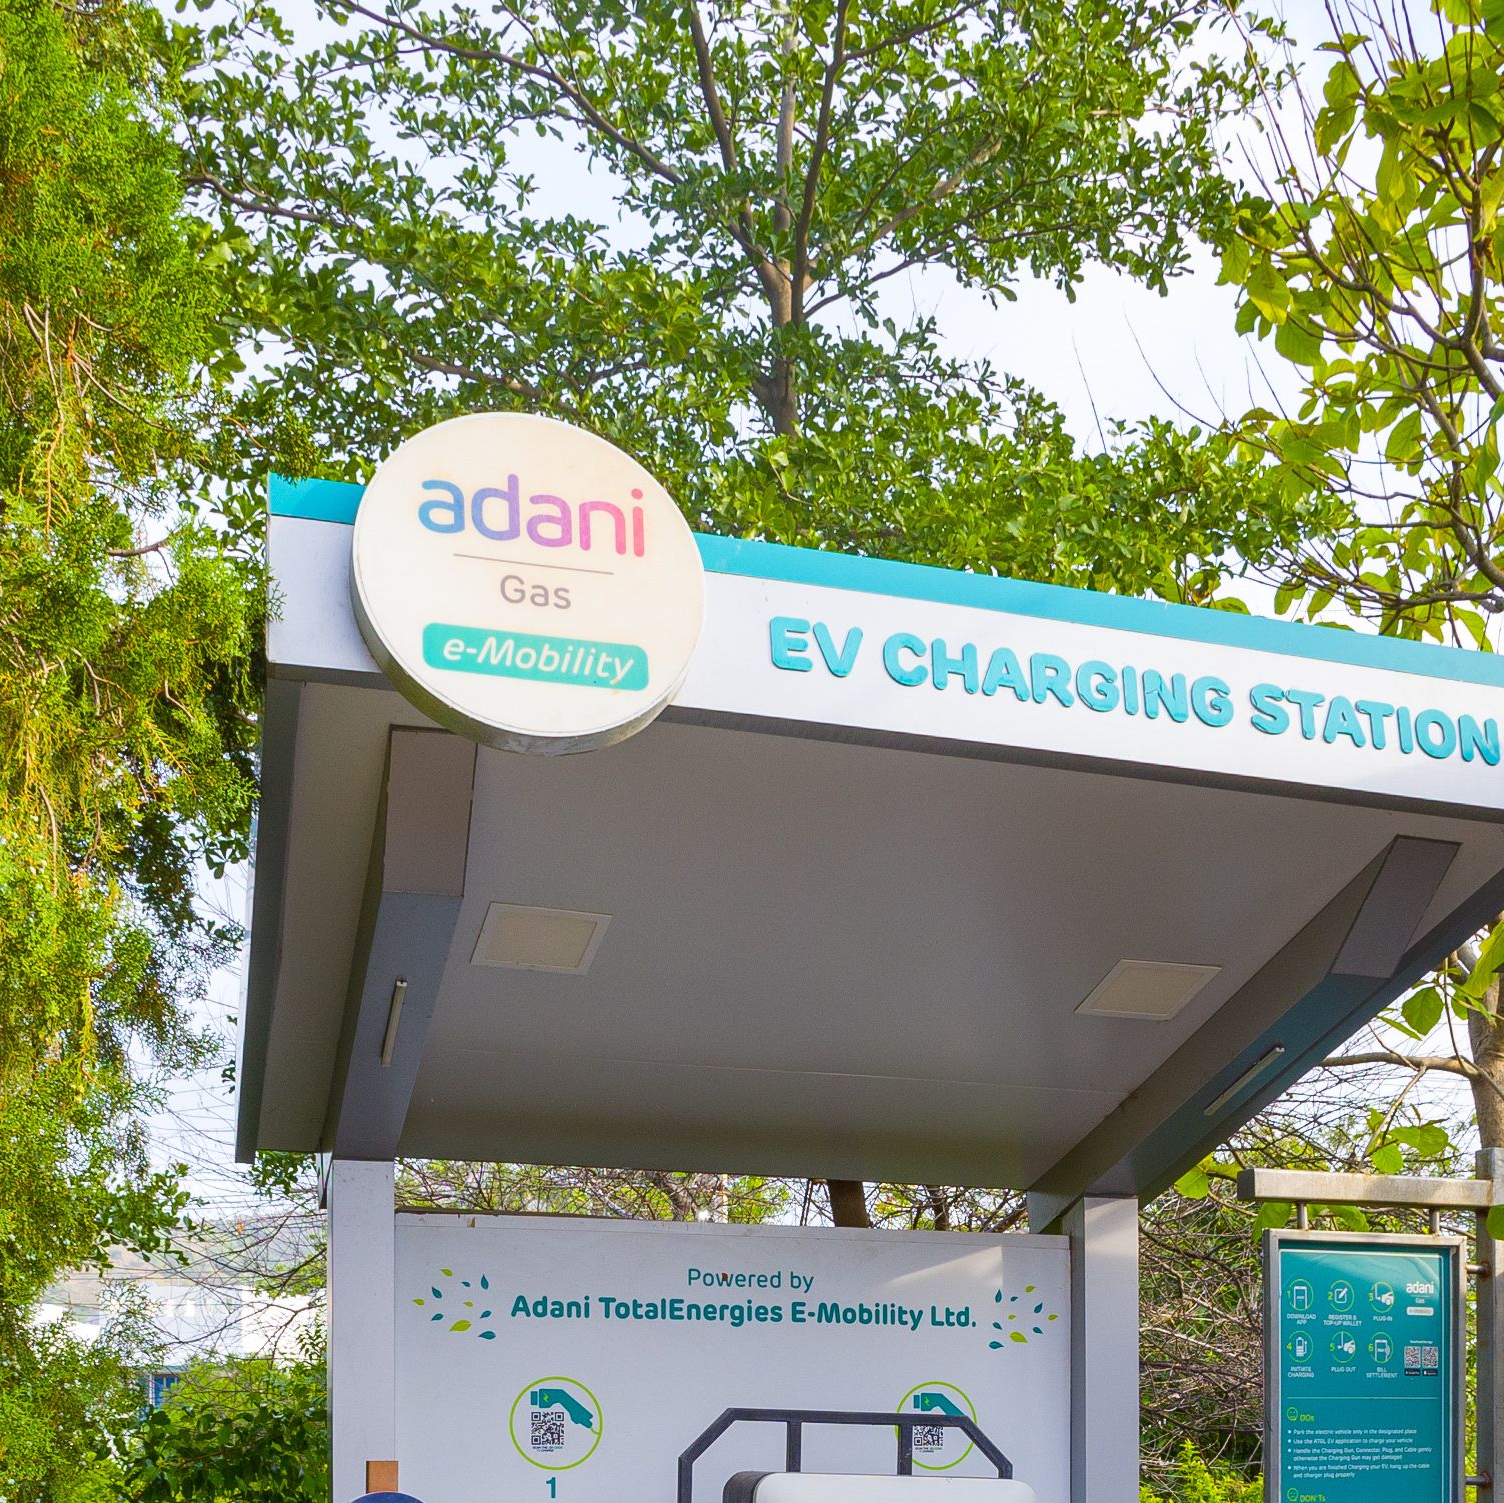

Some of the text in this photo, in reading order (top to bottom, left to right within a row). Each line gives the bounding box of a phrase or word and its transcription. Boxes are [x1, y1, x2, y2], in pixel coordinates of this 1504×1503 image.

[418, 474, 644, 557] adani
[500, 575, 571, 609] Gas
[443, 637, 634, 685] e-Mobility
[769, 616, 1501, 767] EV CHARGING STATION
[688, 1268, 814, 1293] Powered by
[1406, 1281, 1434, 1294] adani
[1328, 1291, 1333, 1300] 2
[1368, 1293, 1374, 1301] 3
[511, 1295, 976, 1331] Adani TotalEnergies E-Mobility Ltd.
[1286, 1342, 1292, 1350] 4
[1330, 1342, 1335, 1352] 5
[1368, 1343, 1374, 1352] 6
[546, 1477, 556, 1498] 1
